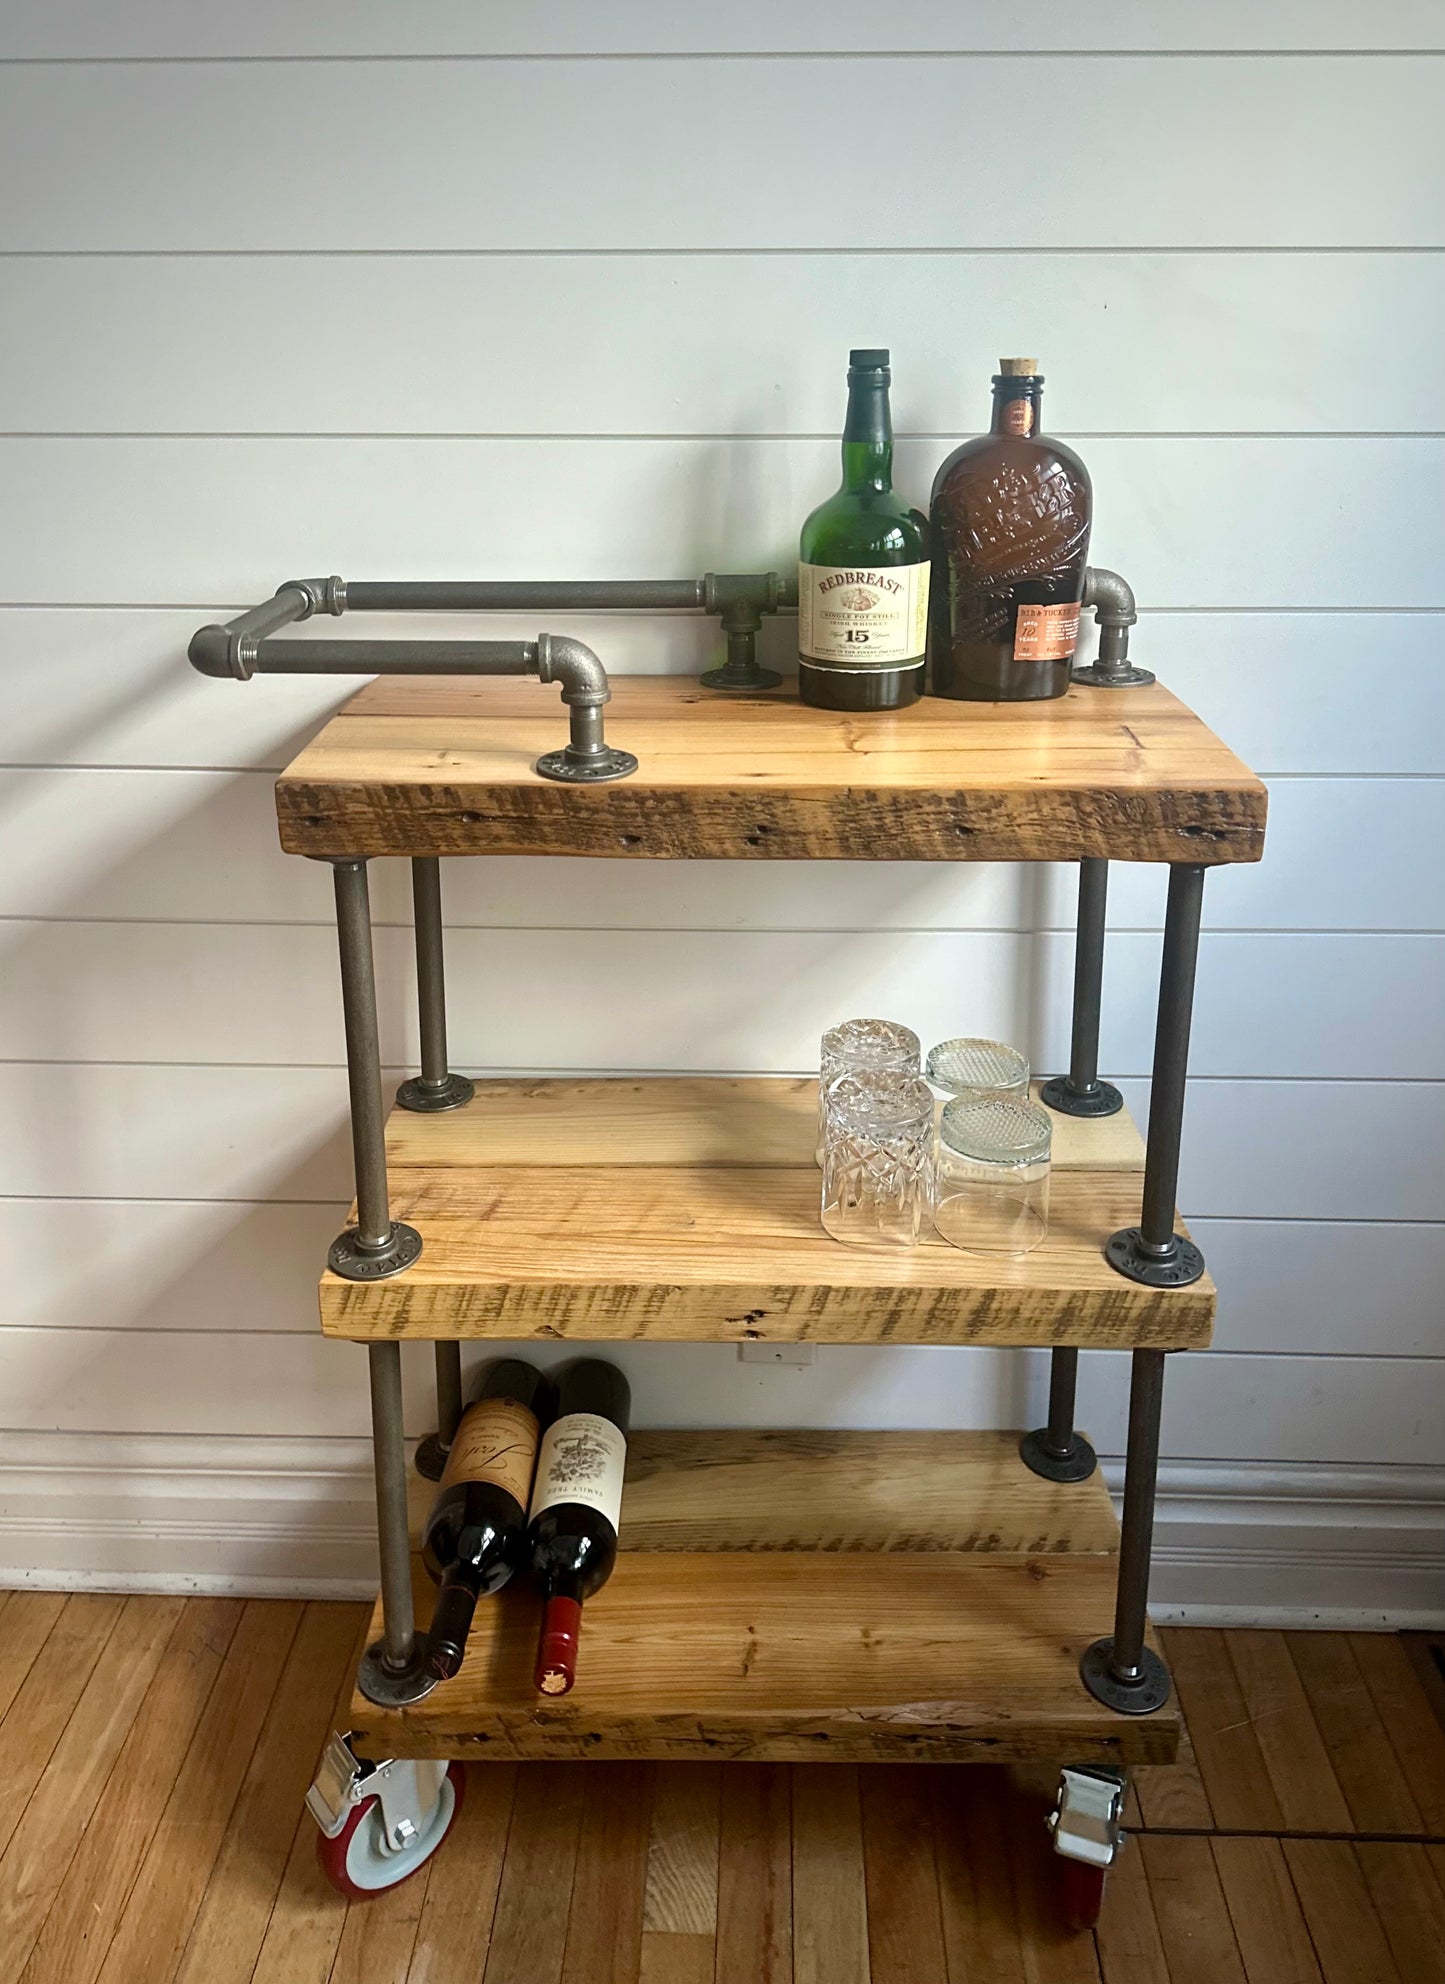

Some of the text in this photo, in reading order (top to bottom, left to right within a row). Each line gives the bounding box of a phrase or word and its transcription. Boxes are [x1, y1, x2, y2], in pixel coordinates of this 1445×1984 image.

[818, 571, 902, 595] REDBREAST
[844, 629, 869, 643] 15
[1022, 627, 1036, 636] 10
[573, 1486, 604, 1497] FAMILY
